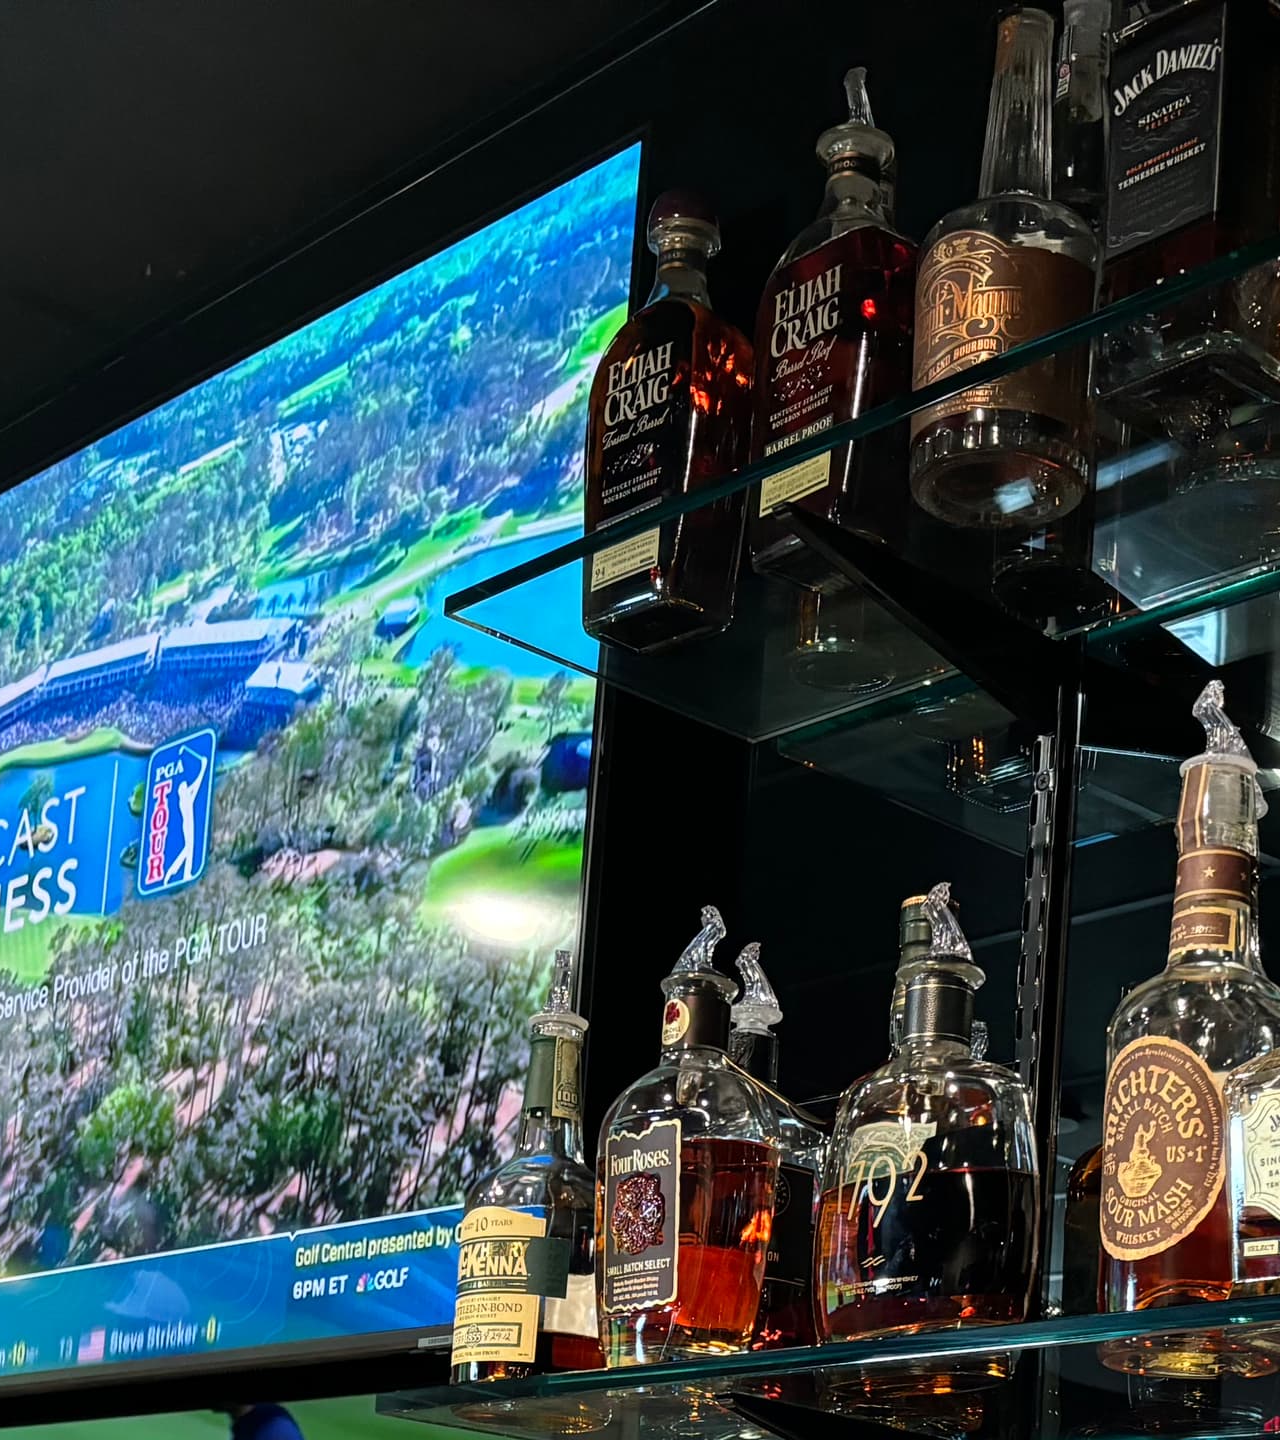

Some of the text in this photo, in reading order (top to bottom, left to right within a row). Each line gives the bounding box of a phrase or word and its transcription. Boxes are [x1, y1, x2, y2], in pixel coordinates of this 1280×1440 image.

[1113, 38, 1222, 116] JACK DANIEL'S
[1138, 93, 1192, 128] SINATRA
[1167, 143, 1207, 167] WHISKEY
[773, 264, 843, 326] ELIJAH
[771, 297, 839, 359] CRAIG
[607, 341, 675, 396] ELIJAH
[604, 377, 670, 427] CRAIG
[765, 428, 801, 457] BARREL
[155, 759, 184, 782] PGA
[147, 780, 172, 885] TOUR
[54, 964, 116, 1007] Provider
[174, 933, 213, 967] PGA
[219, 915, 267, 957] TOUR
[1143, 1097, 1173, 1135] BATCH
[837, 1150, 928, 1229] 1792
[1137, 1177, 1194, 1228] MASH
[295, 1227, 434, 1268] Golf Central presented
[1115, 1227, 1162, 1246] WHISKEY
[645, 1258, 670, 1269] SELECT
[293, 1275, 348, 1299] 6PM ET
